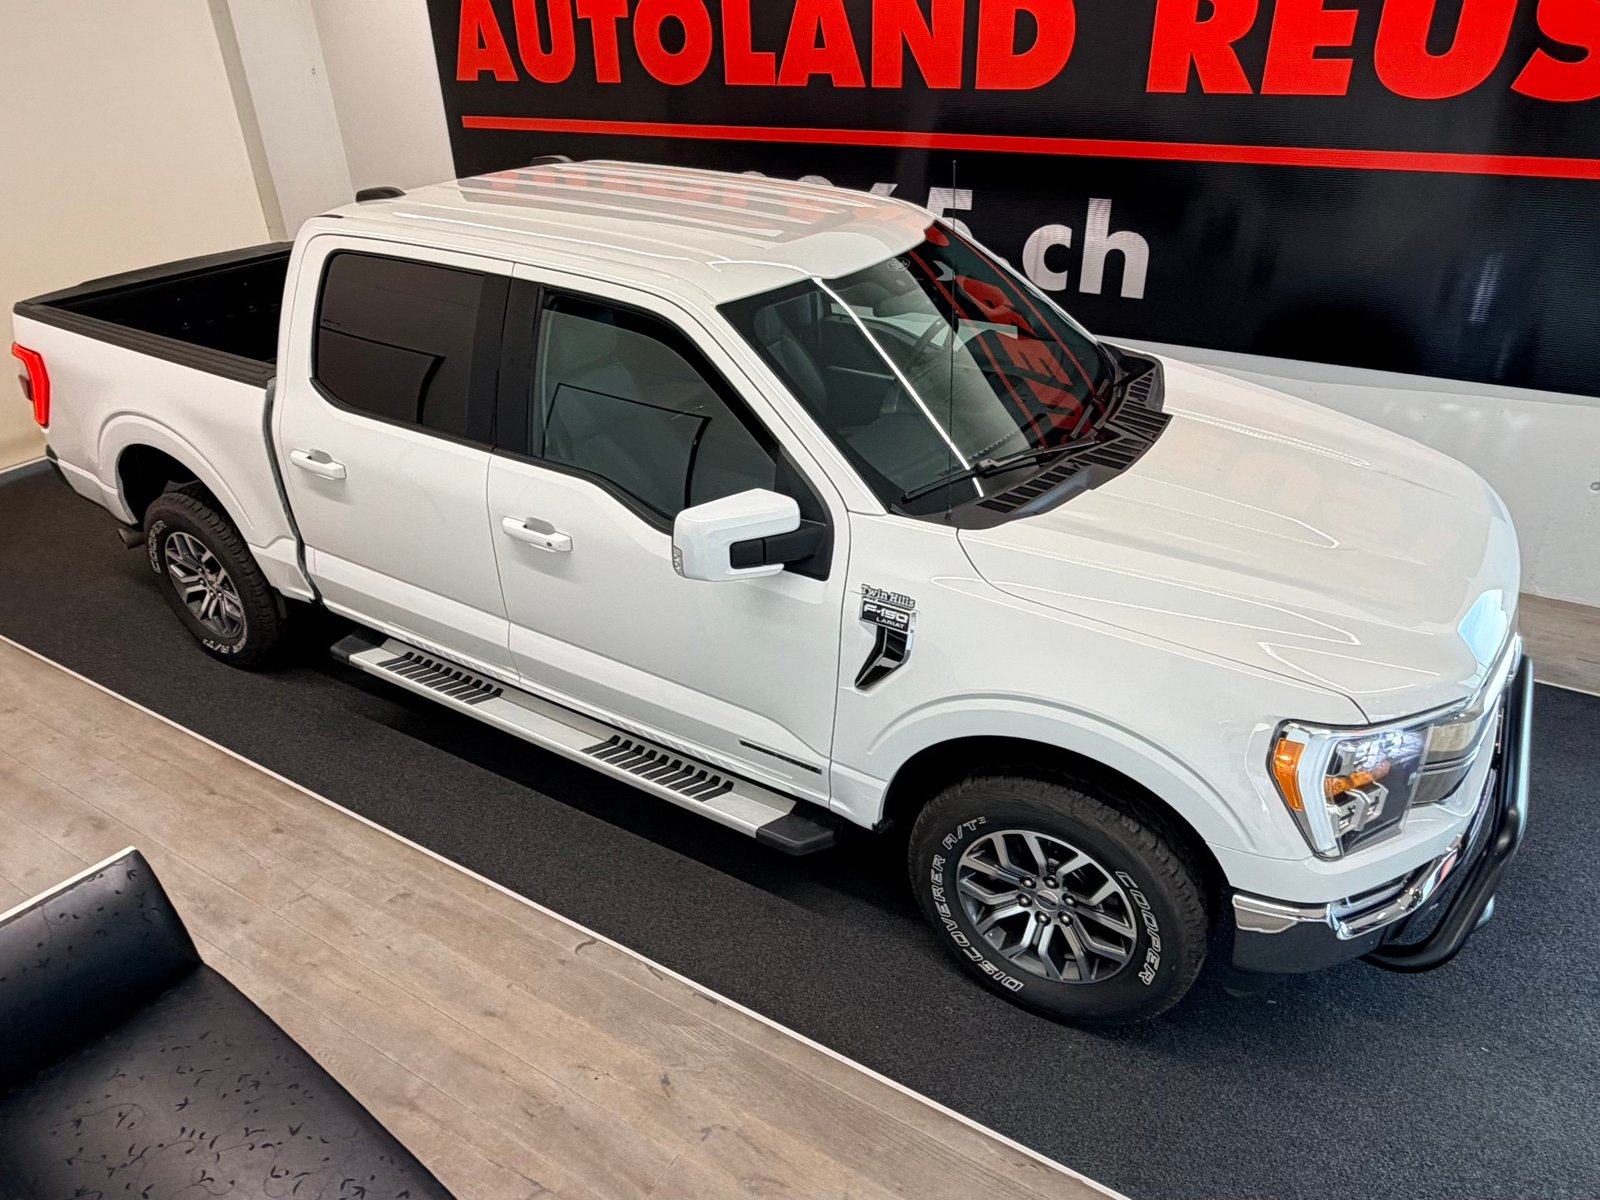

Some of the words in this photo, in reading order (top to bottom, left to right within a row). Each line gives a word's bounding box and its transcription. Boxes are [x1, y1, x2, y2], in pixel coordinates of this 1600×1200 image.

[456, 0, 1076, 90] AUTOLAND
[861, 583, 888, 600] Twin
[889, 591, 916, 609] Hills
[864, 603, 909, 623] F-150
[876, 616, 905, 629] LARIAT
[930, 854, 1024, 993] DISCOVERER
[1115, 870, 1162, 986] COOPER
